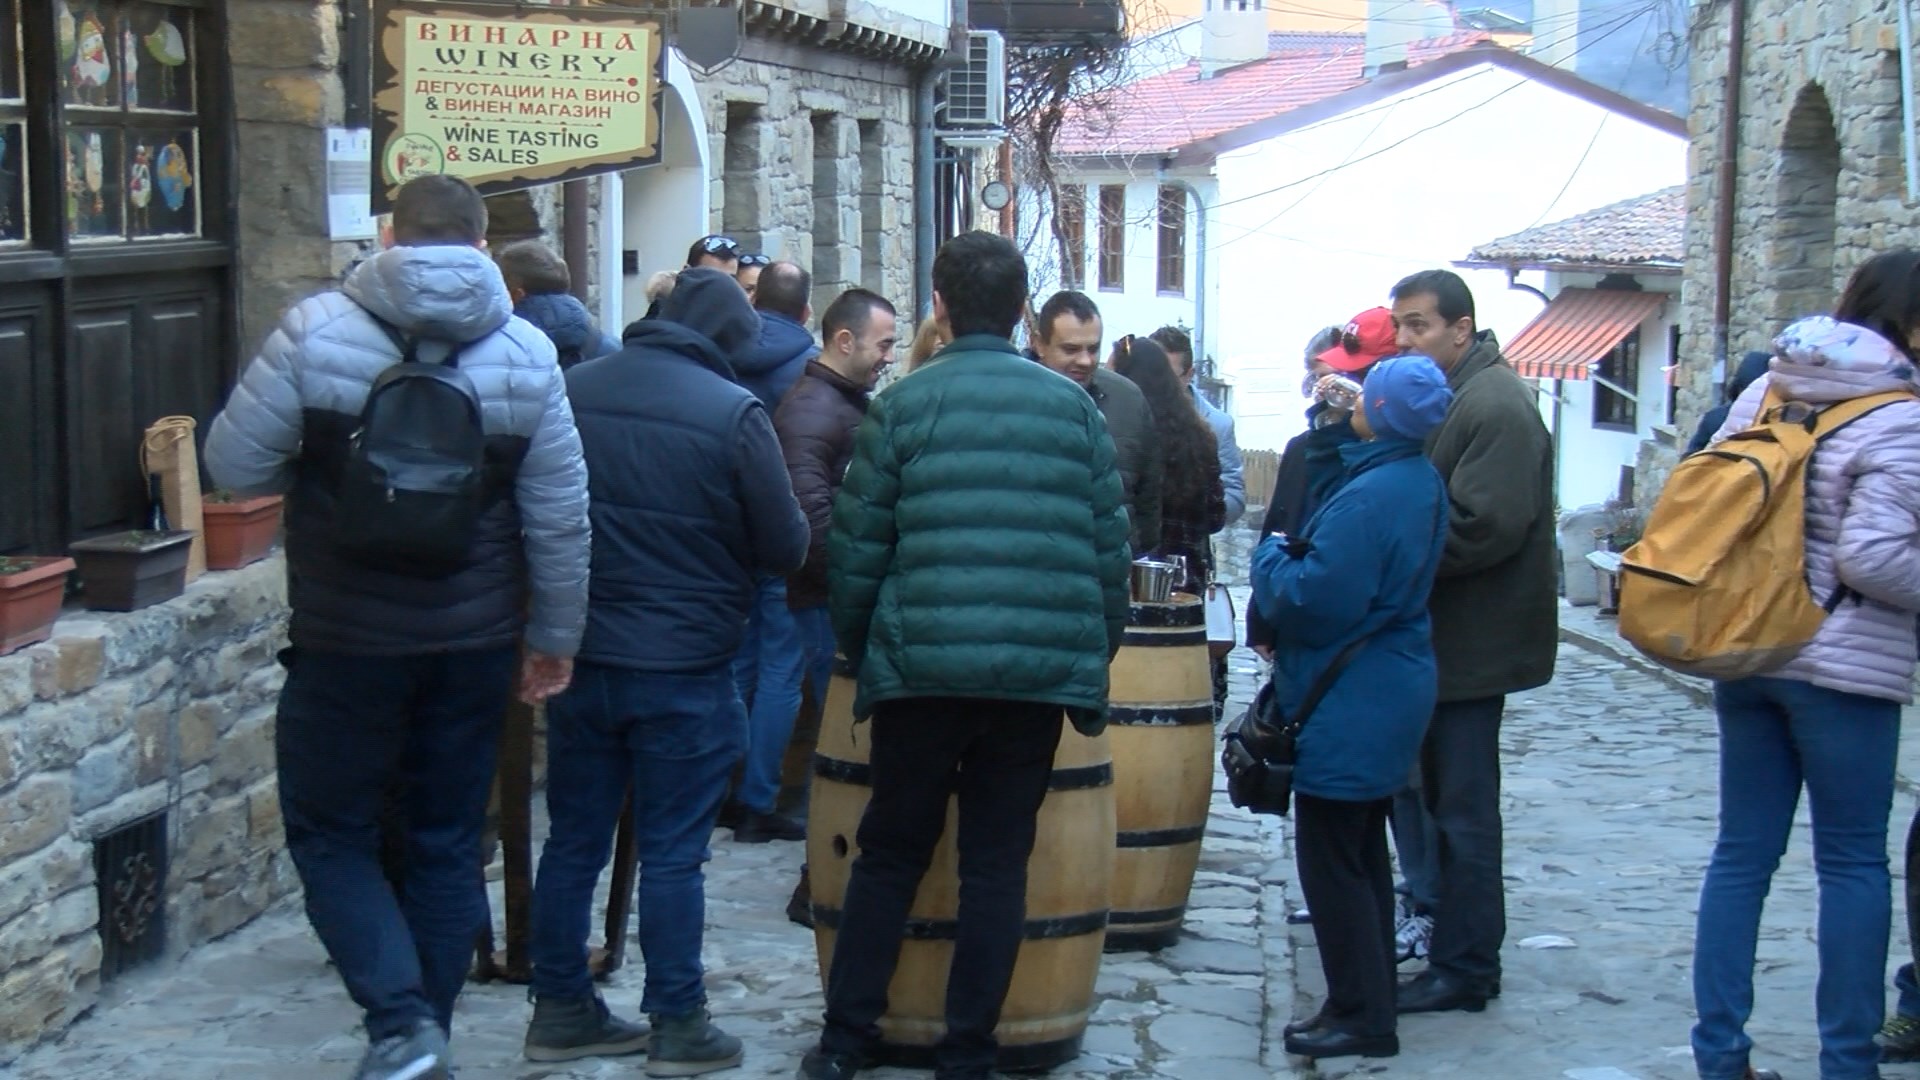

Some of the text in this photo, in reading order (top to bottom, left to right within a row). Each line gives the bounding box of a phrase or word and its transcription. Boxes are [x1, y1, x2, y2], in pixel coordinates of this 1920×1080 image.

[419, 23, 636, 51] ВИНАРНА
[436, 48, 617, 73] WINERY
[415, 79, 641, 104] ДЕГУСТАЦИИ НА ВИНО
[426, 97, 612, 119] & ВИНЕН МАГАЗИН
[446, 146, 461, 162] &
[468, 148, 539, 165] SALES
